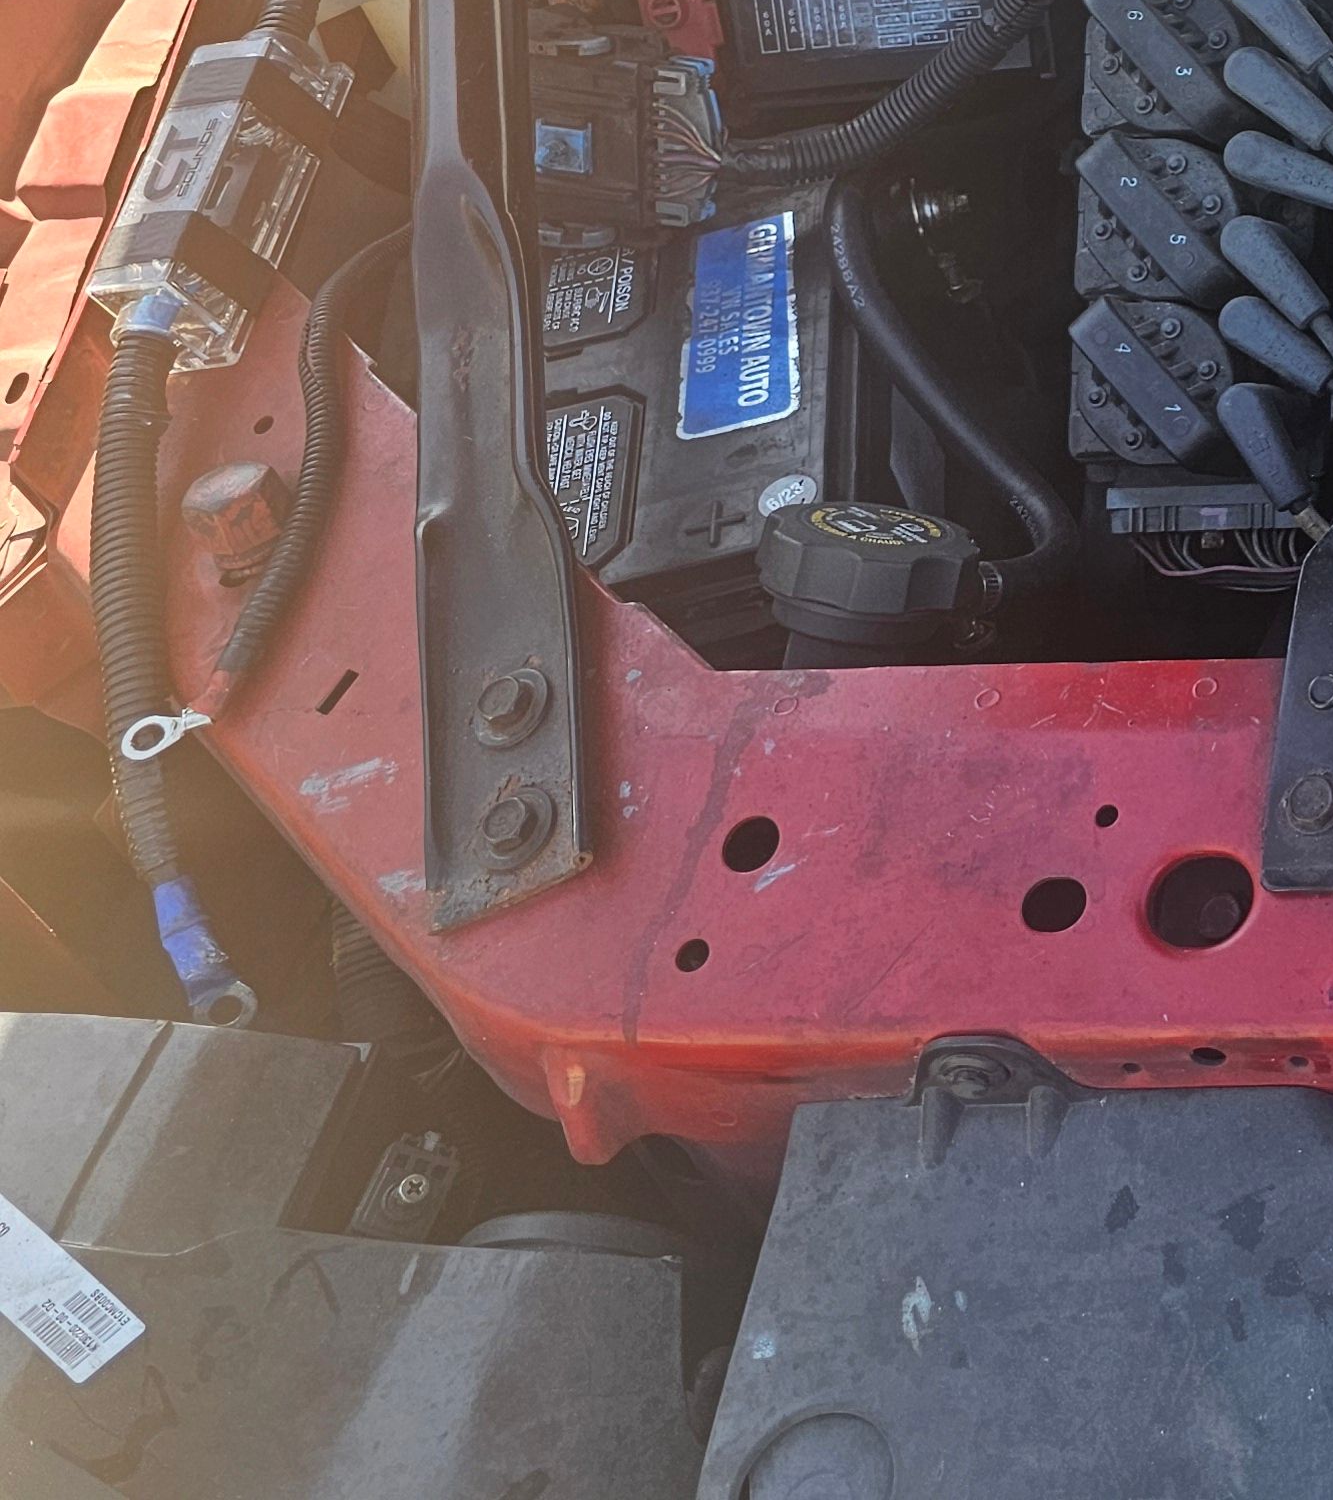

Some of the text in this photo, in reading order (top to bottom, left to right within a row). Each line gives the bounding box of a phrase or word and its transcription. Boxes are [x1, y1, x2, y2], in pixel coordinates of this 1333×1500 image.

[1175, 64, 1193, 77] 3
[177, 117, 220, 197] SOUNDS
[1120, 176, 1138, 188] 2
[1169, 233, 1187, 246] 5
[614, 265, 633, 312] POISON
[718, 310, 740, 355] SALES
[1114, 342, 1132, 354] 4
[737, 354, 770, 406] AUTO
